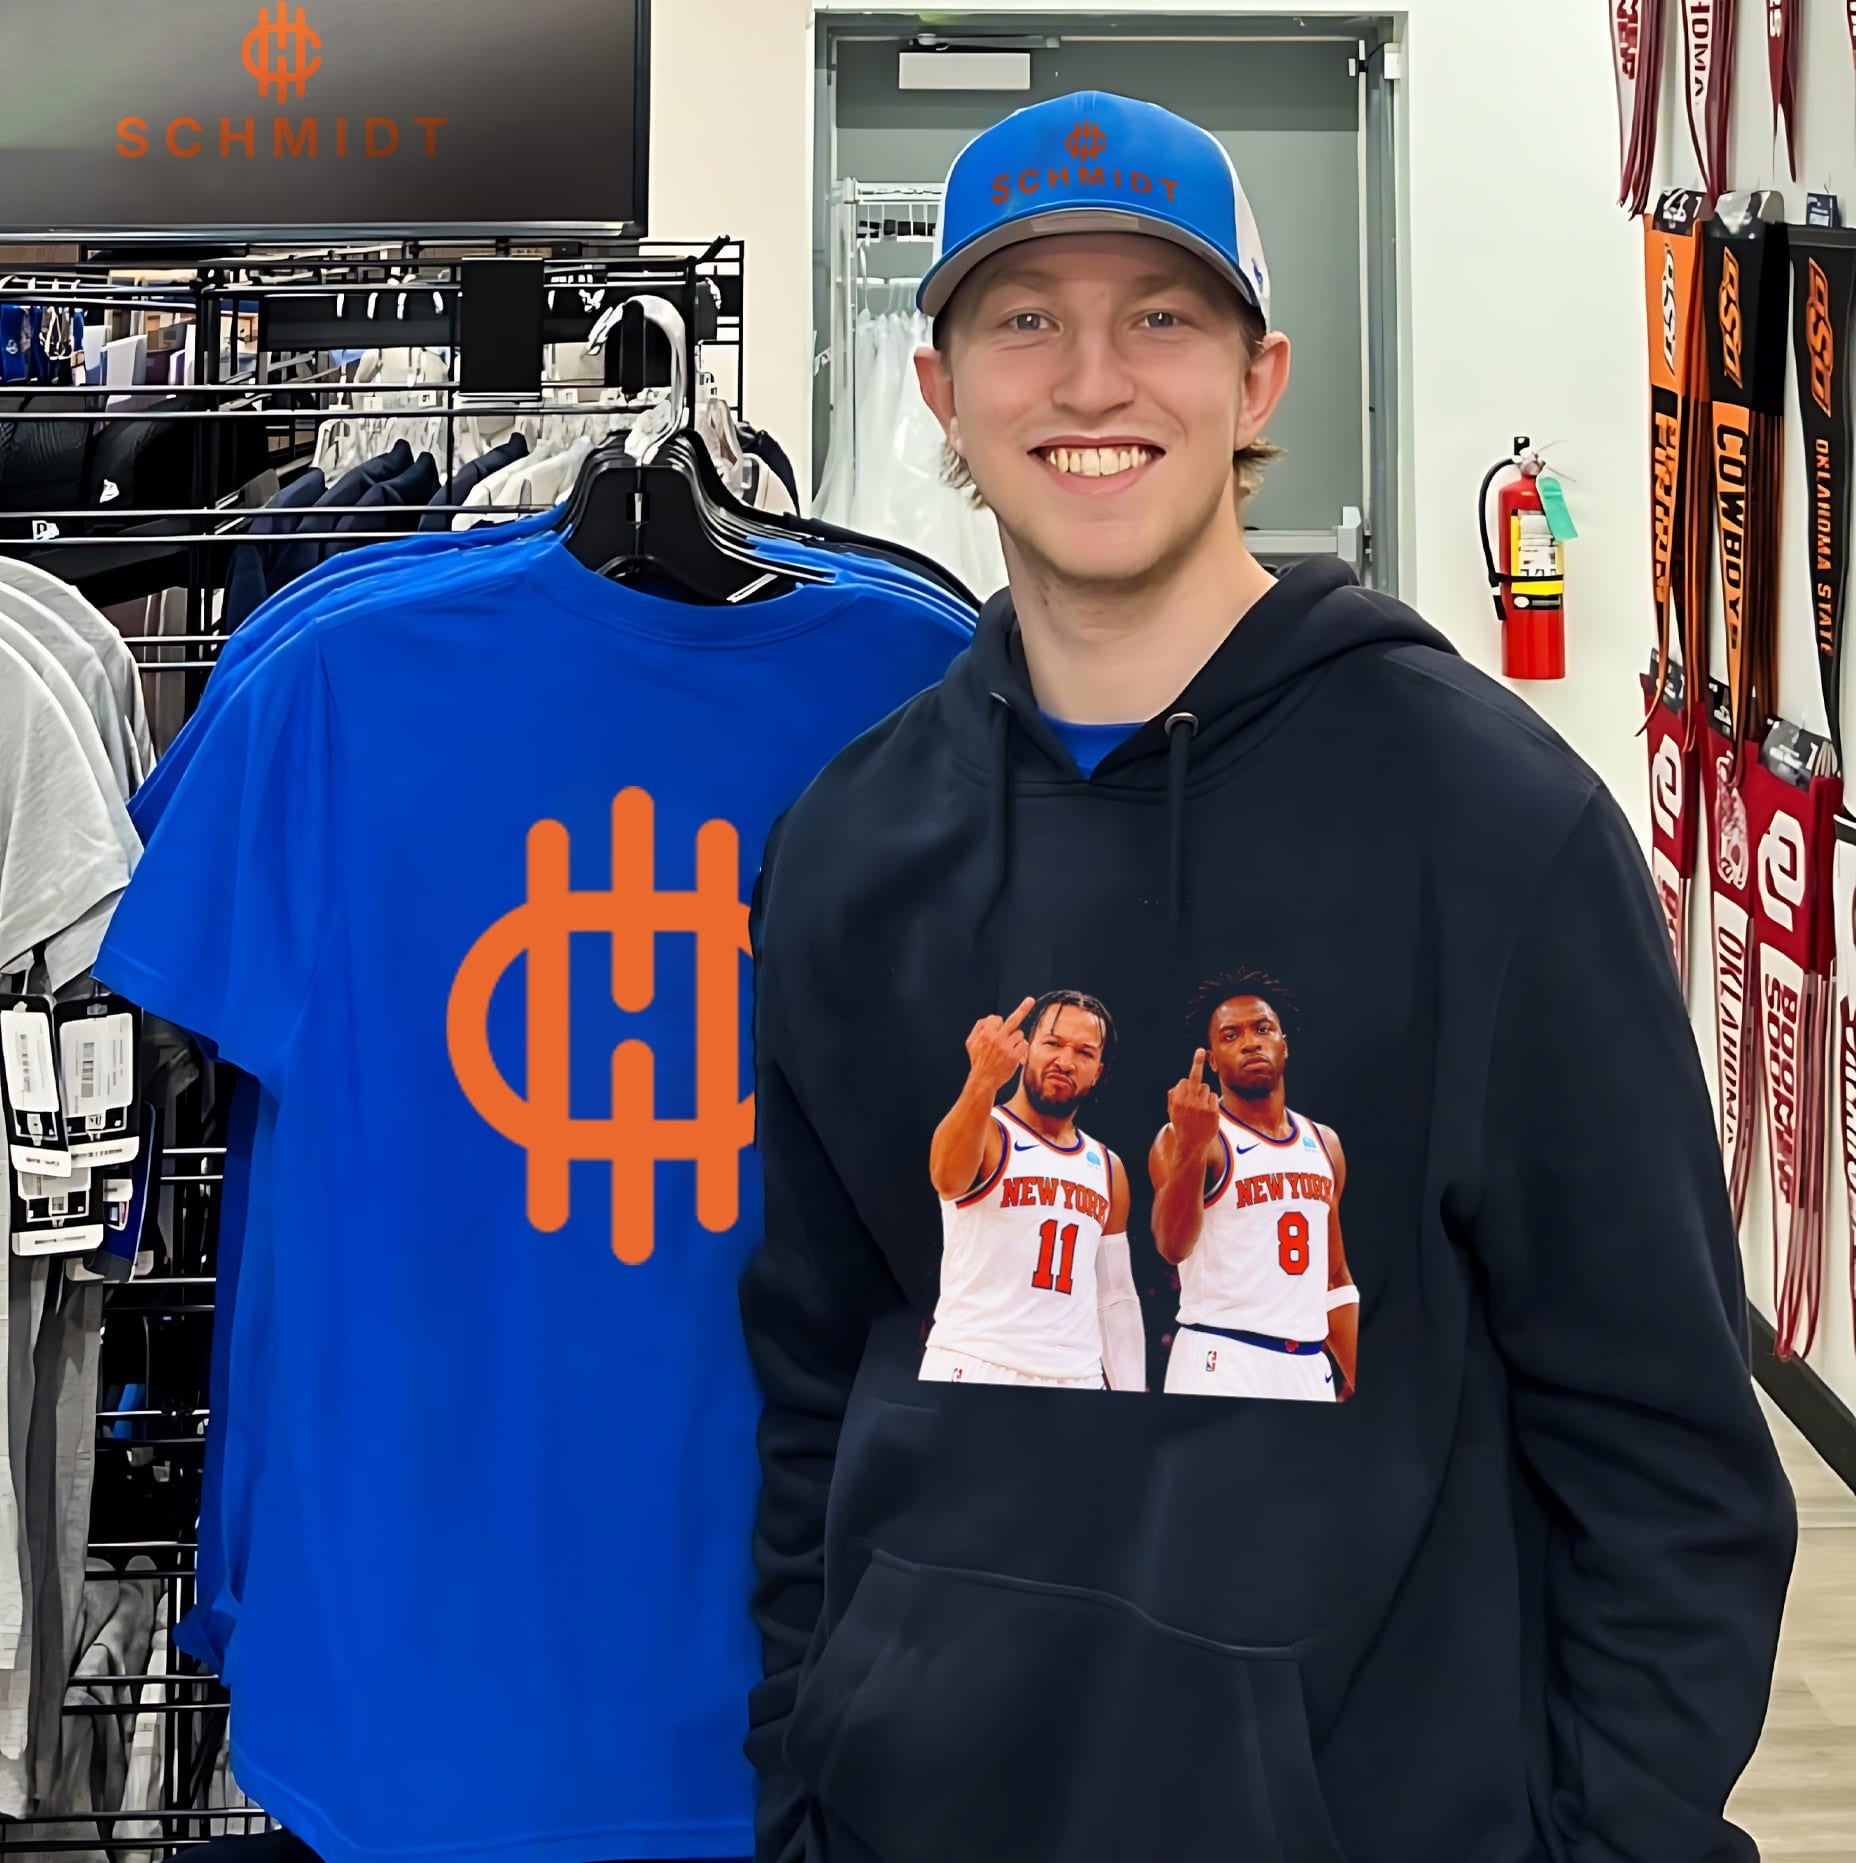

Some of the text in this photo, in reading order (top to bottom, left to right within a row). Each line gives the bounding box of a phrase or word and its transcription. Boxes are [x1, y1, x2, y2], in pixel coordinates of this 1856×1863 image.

[115, 116, 448, 159] SCHMIDT
[991, 166, 1179, 204] SCHMIDT
[1718, 925, 1745, 1144] OKLAHOMA
[1000, 1176, 1110, 1223] NEW YORK
[1235, 1172, 1333, 1209] NEW YORK
[1031, 1219, 1079, 1295] 11
[1277, 1210, 1310, 1276] 8
